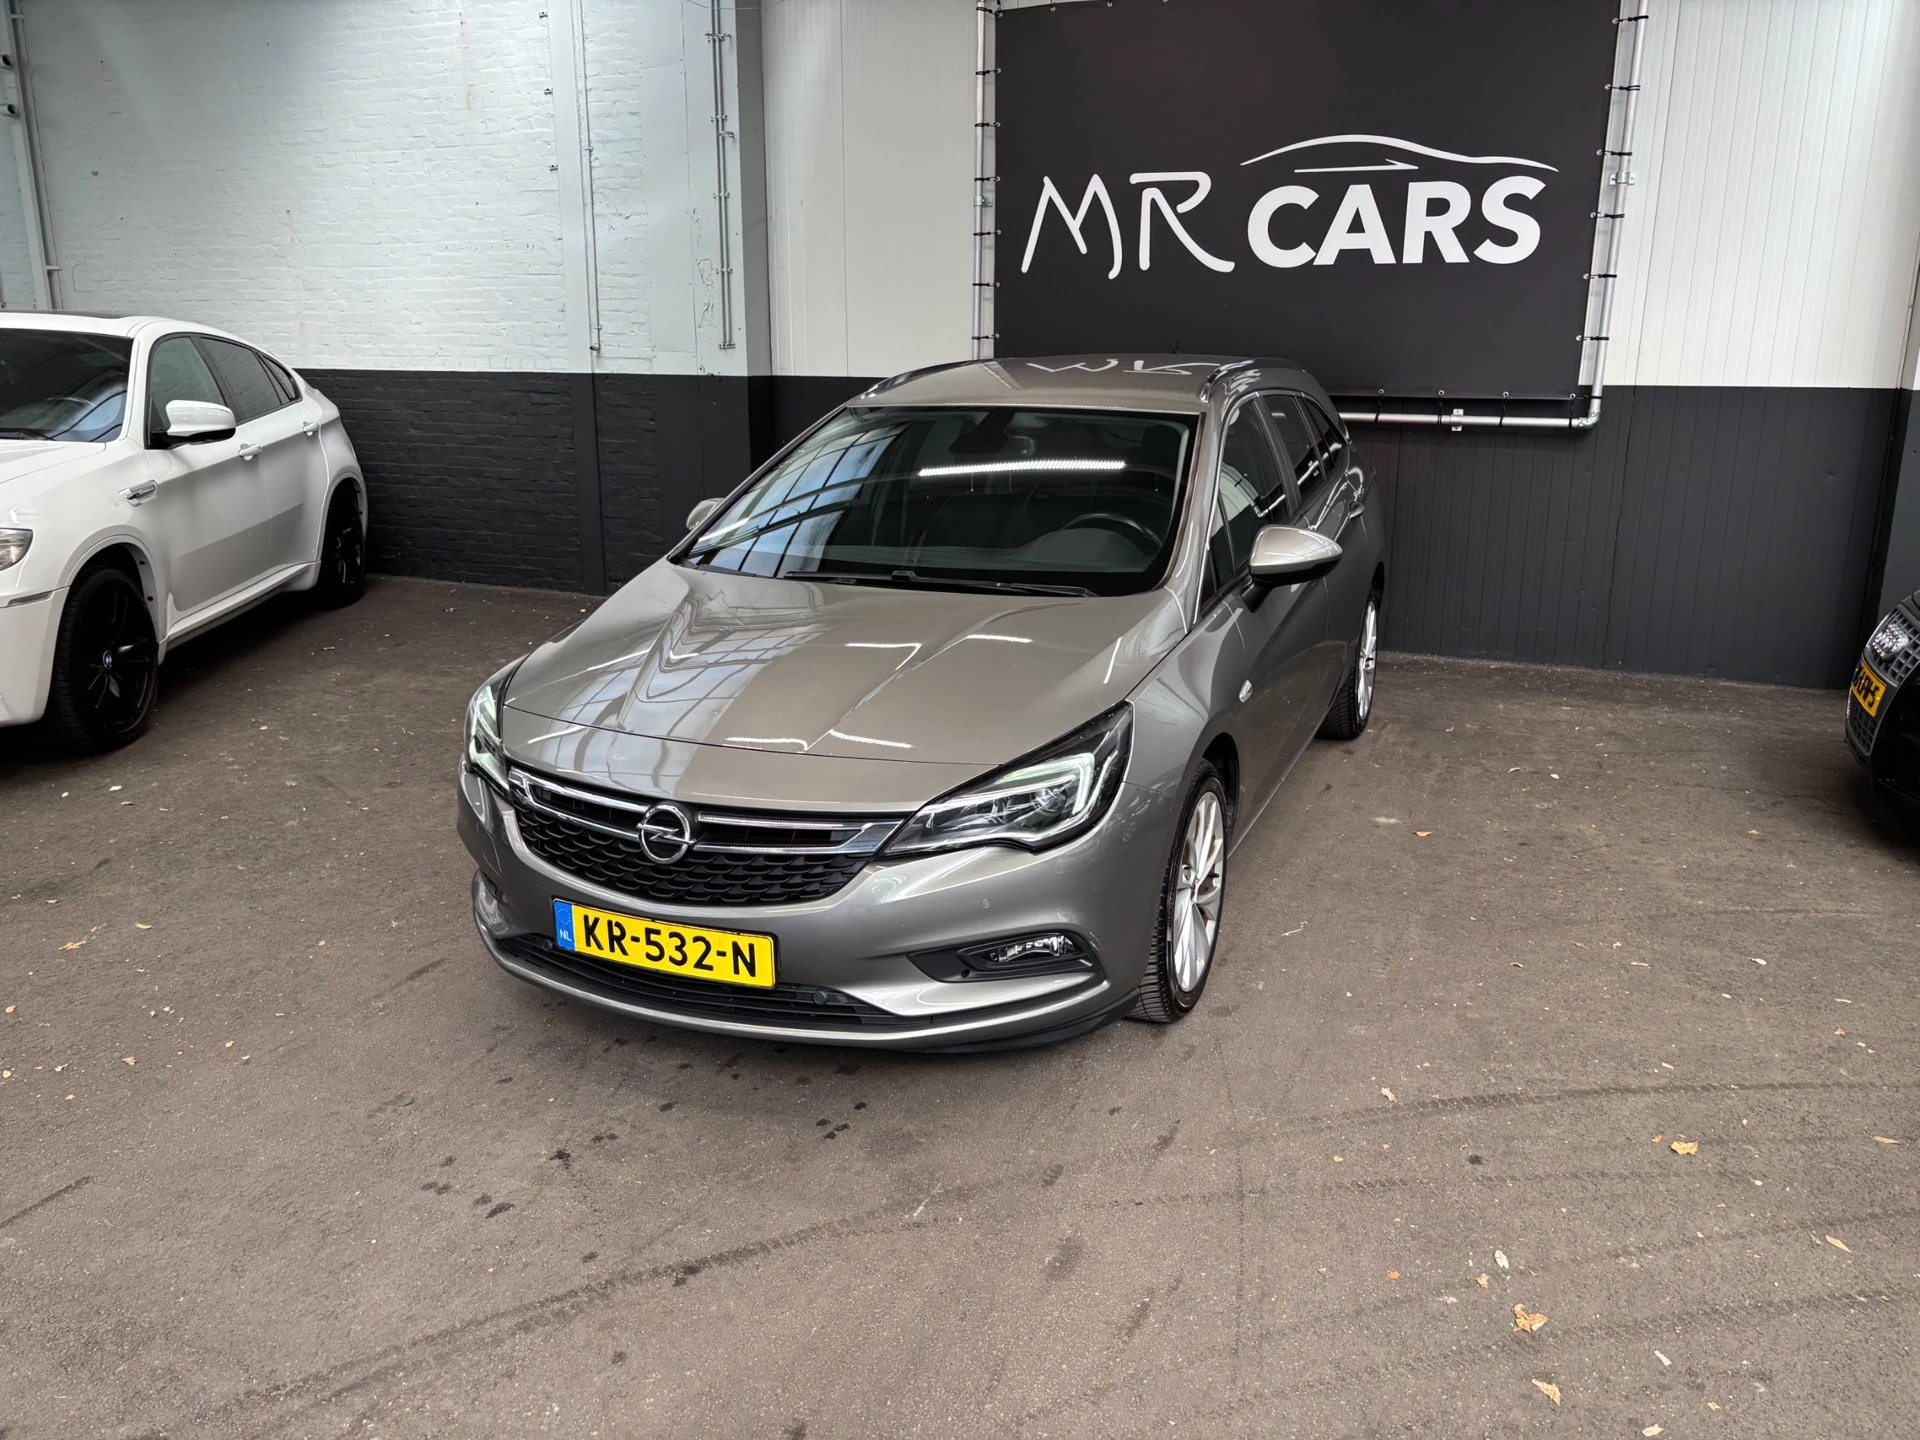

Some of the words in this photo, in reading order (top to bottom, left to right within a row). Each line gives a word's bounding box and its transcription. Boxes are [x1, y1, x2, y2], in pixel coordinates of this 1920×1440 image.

[1021, 171, 1235, 279] MR
[1247, 175, 1546, 268] CARS
[559, 928, 573, 942] NL
[583, 914, 757, 977] KR-532-N
